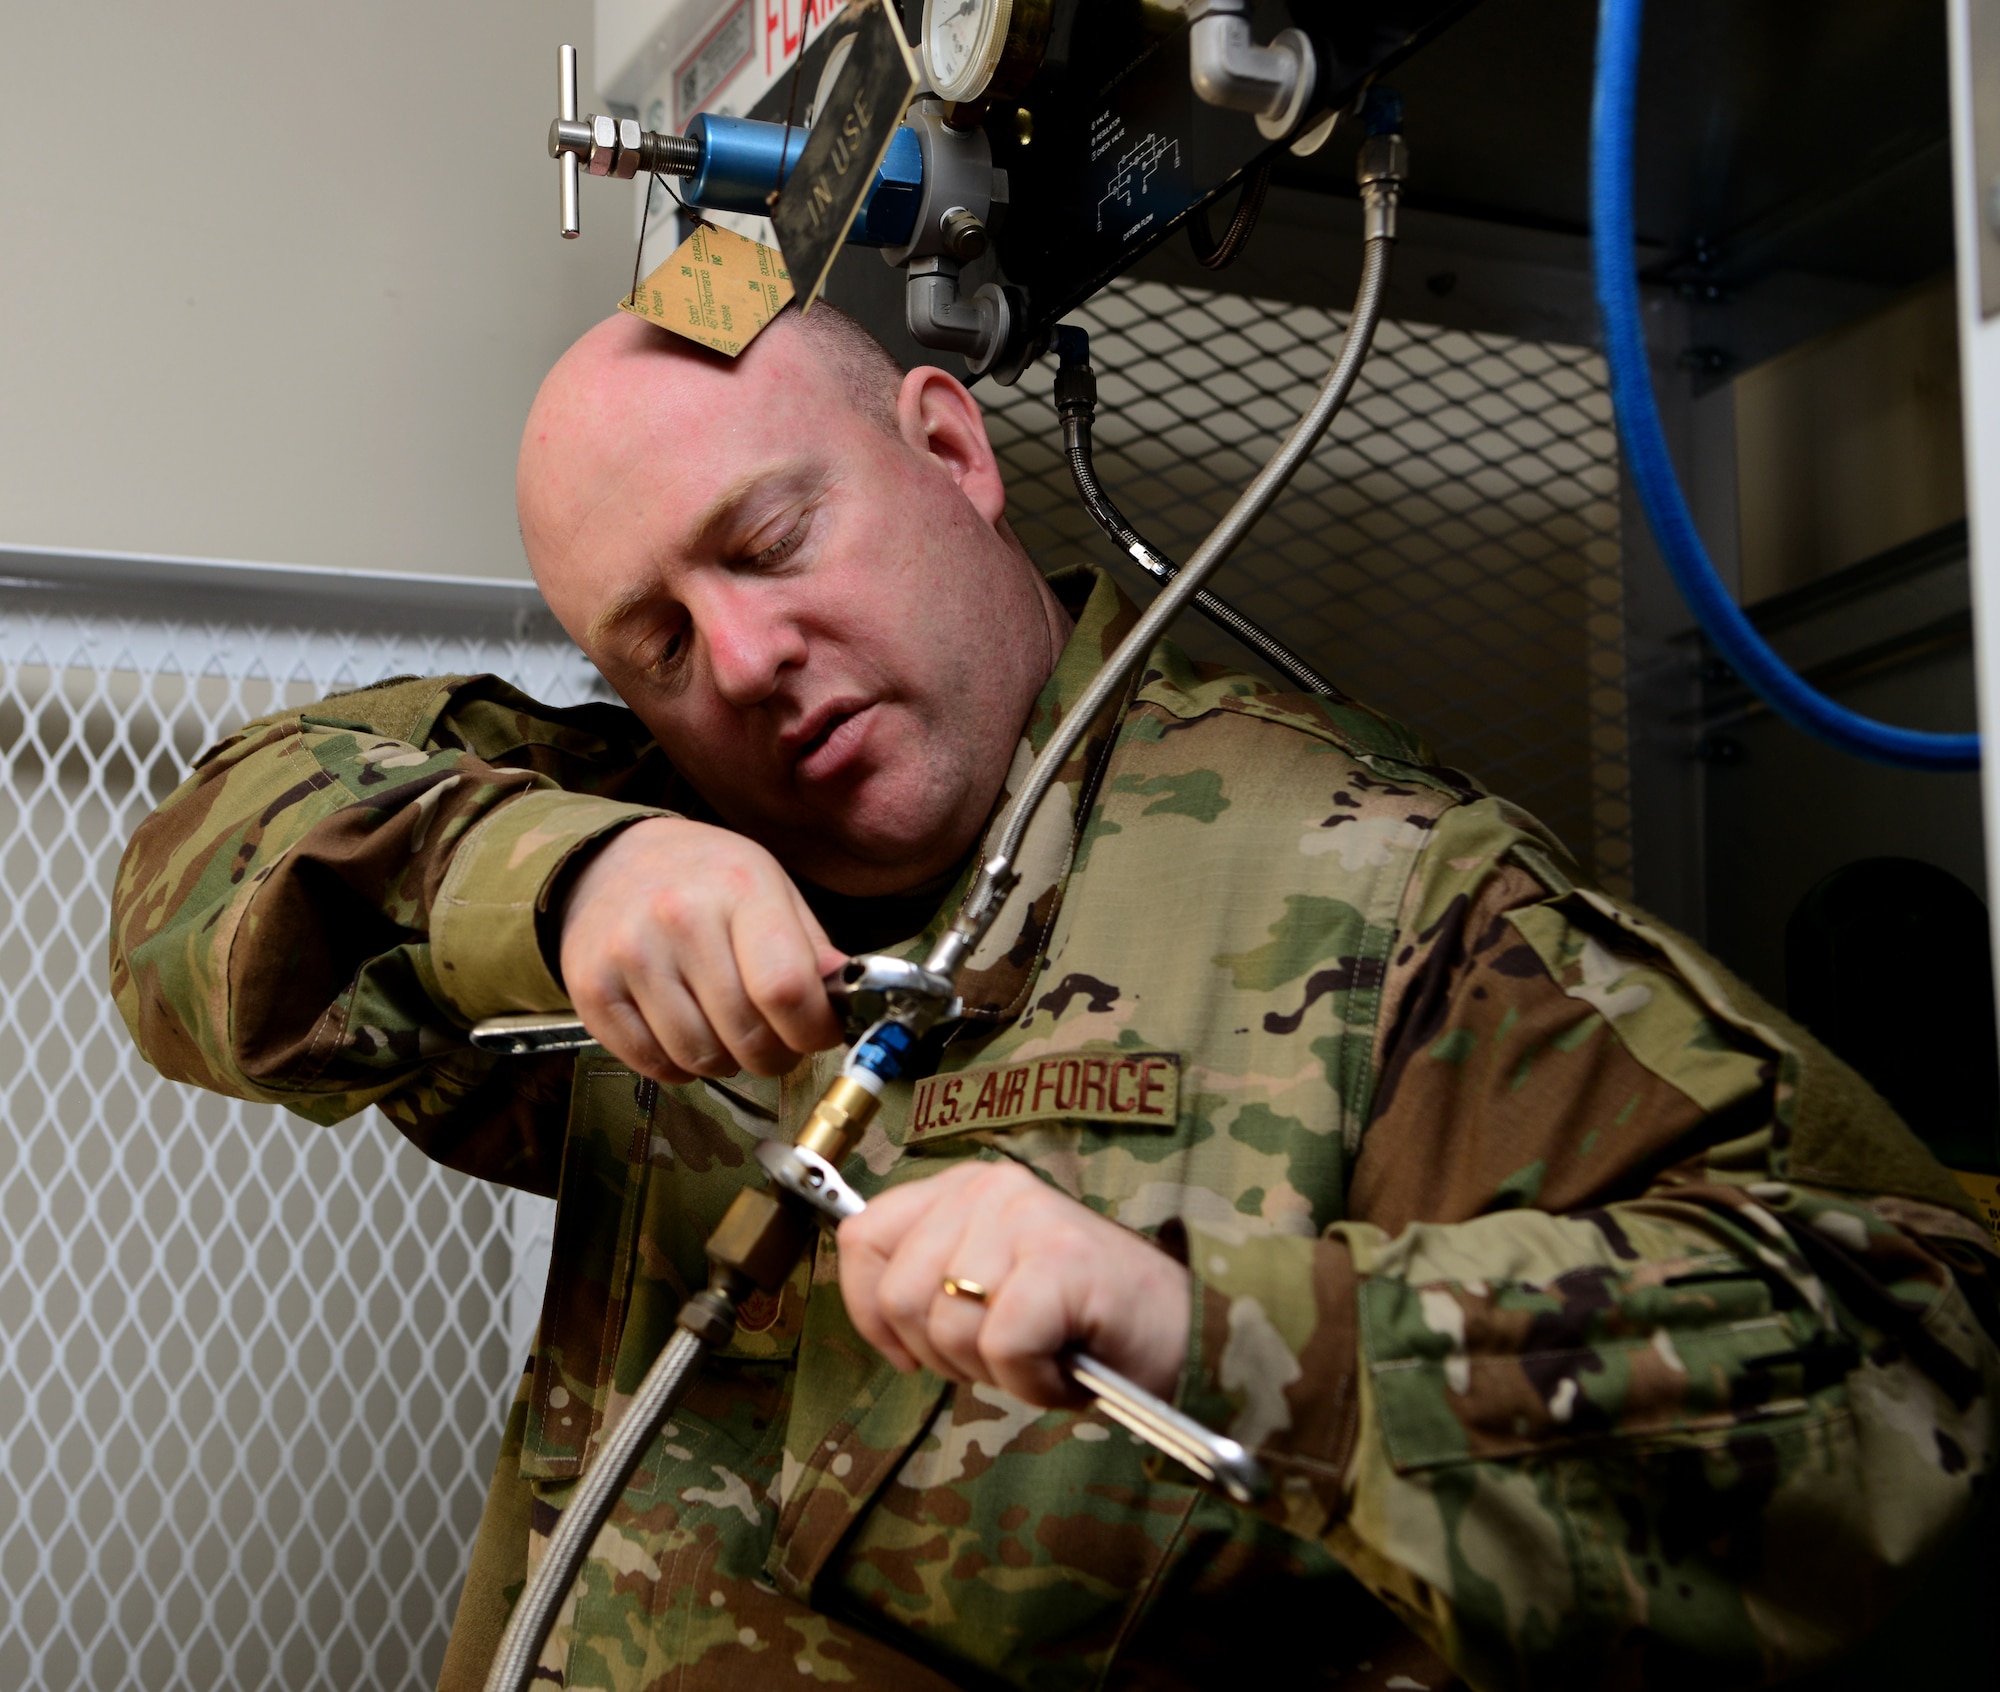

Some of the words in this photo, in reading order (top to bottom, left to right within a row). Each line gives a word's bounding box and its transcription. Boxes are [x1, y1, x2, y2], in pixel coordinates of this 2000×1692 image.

[1096, 109, 1110, 125] VALVE
[1096, 116, 1120, 142] REGULATOR
[1096, 139, 1111, 156] CHECK
[1111, 127, 1125, 143] VALVE
[807, 174, 832, 227] IN
[831, 87, 874, 175] USE
[1123, 222, 1141, 241] OXYGEN
[1140, 212, 1154, 227] FLOW
[681, 265, 692, 277] 3M
[700, 269, 715, 308] Performance
[749, 280, 760, 292] 3M
[653, 290, 664, 318] Adhesive
[721, 304, 733, 333] Adhesive
[914, 1078, 963, 1132] U.S.
[969, 1067, 1030, 1120] AIR
[1032, 1059, 1167, 1115] FORCE
